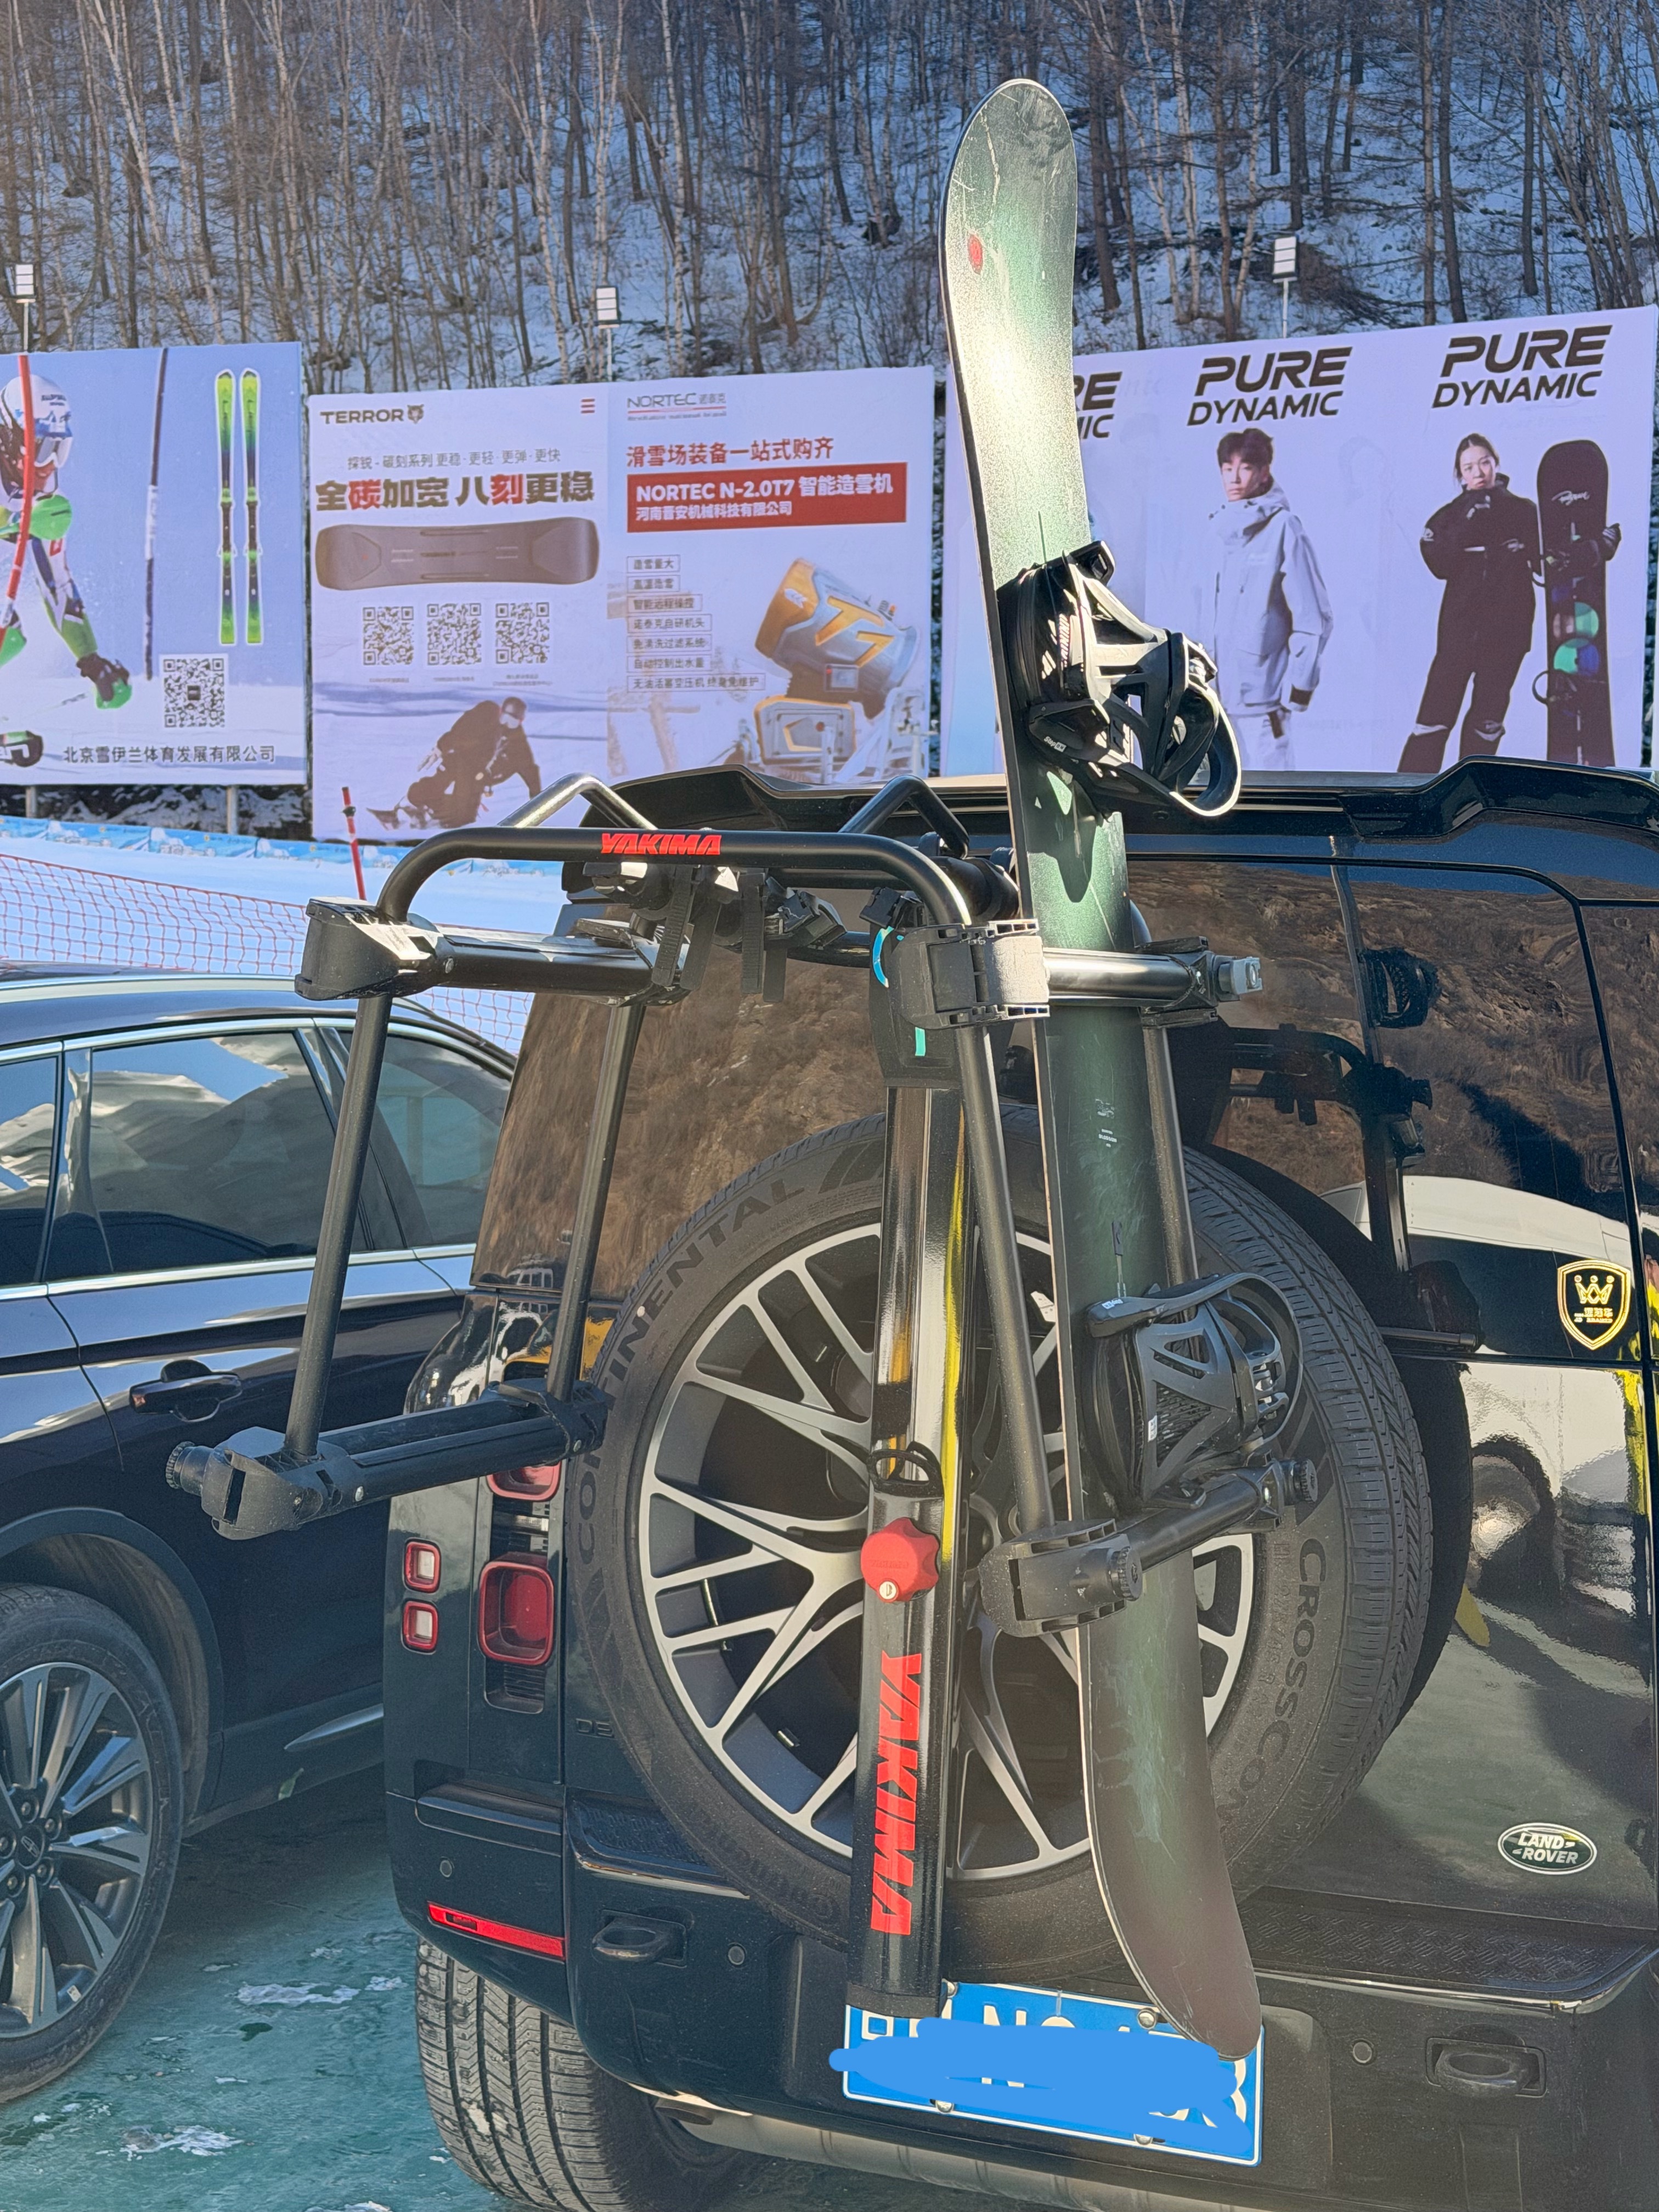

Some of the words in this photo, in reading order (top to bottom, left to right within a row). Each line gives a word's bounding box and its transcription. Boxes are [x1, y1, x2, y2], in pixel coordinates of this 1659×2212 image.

[1440, 322, 1613, 377] PURE
[1195, 347, 1353, 396] PURE
[628, 393, 696, 408] NORTEC
[1432, 370, 1602, 408] DYNAMIC
[320, 409, 404, 424] TERROR
[1187, 391, 1344, 426] DYNAMIC
[627, 437, 833, 467] 滑雪场装备一站式购齐
[315, 477, 449, 511] 全碳加宽
[455, 470, 594, 505] 八刻更稳
[636, 482, 715, 502] NORTEC
[719, 479, 795, 499] N-2.0T7
[799, 473, 893, 497] 智能造雪机
[601, 833, 722, 855] YAKIMA
[871, 1650, 922, 1936] YAKIMA
[1517, 1832, 1564, 1849] LAND
[1522, 1847, 1579, 1864] ROVER
